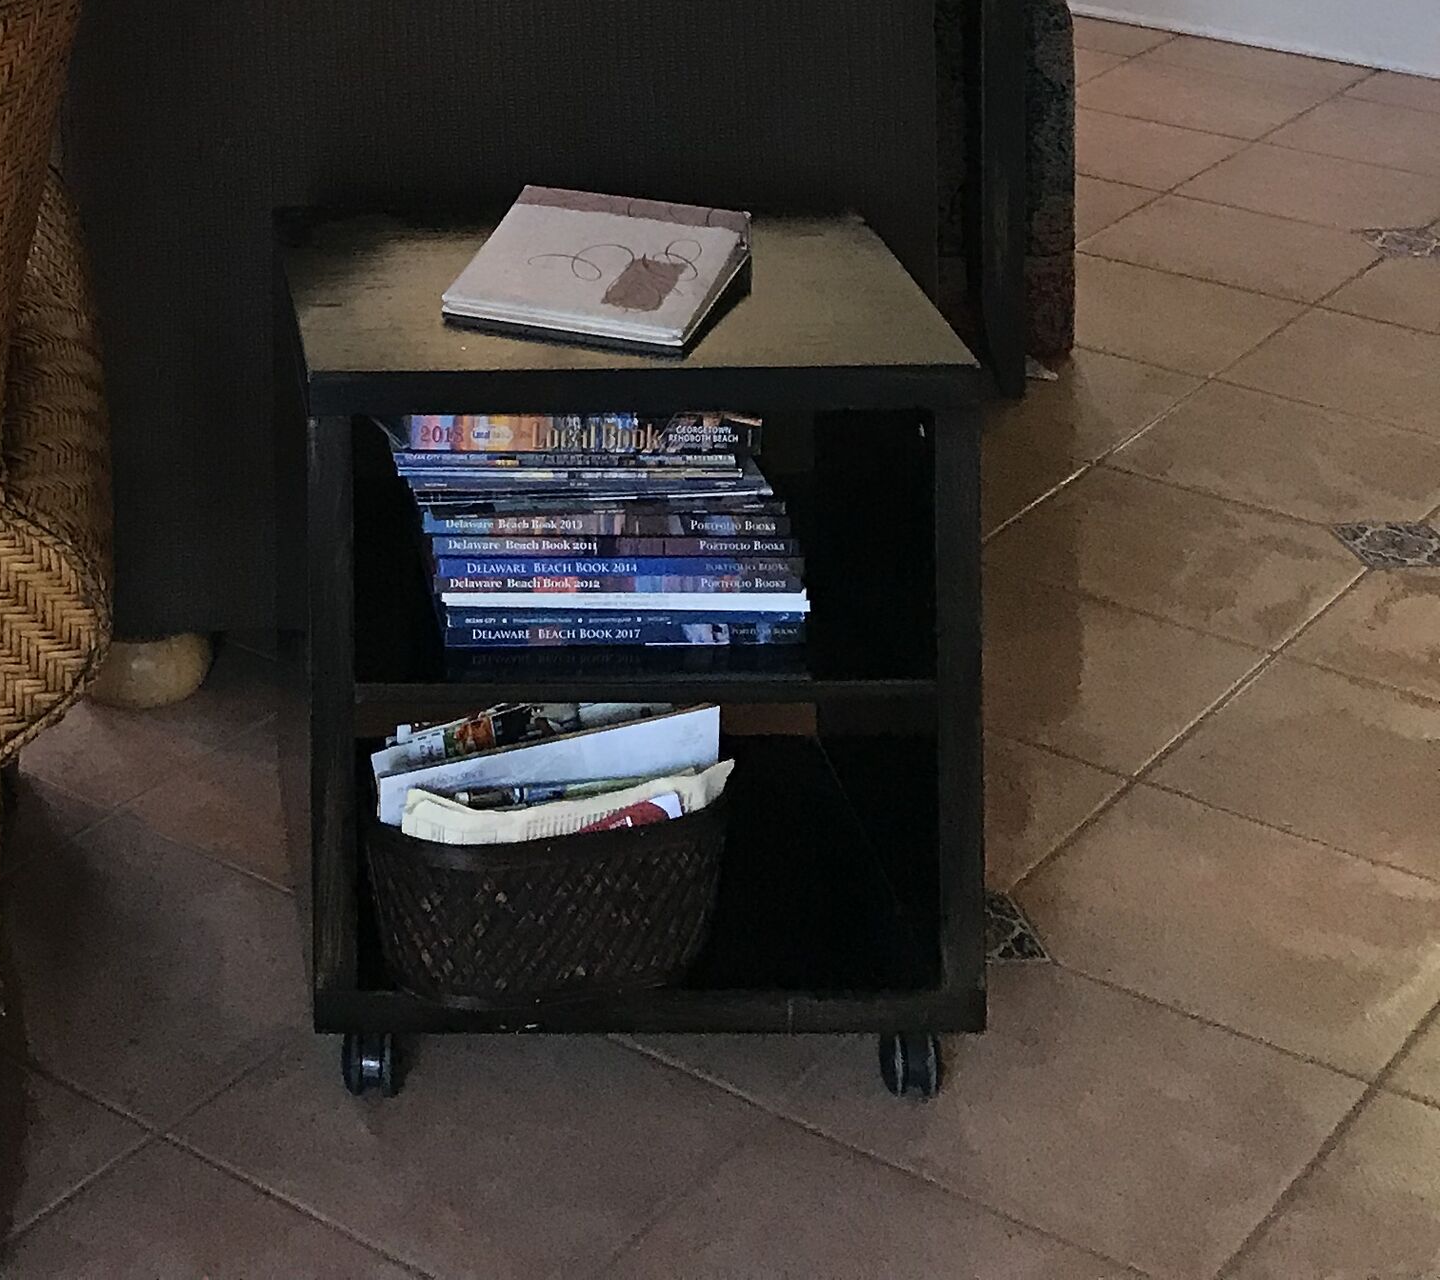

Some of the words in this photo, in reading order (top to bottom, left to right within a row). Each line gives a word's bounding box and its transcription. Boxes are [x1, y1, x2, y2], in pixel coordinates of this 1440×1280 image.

[675, 425, 732, 435] GEORGETOWN
[532, 421, 596, 449] Local
[602, 423, 660, 450] Book
[668, 433, 711, 443] REHOBOTH
[712, 434, 739, 443] BEACH
[445, 519, 494, 529] Delaware
[498, 519, 530, 529] Beach
[531, 519, 557, 529] Book
[448, 540, 501, 550] Delaware
[505, 540, 539, 550] Beach
[541, 540, 571, 550] Book
[467, 562, 527, 574] DELAWARE
[533, 562, 572, 573] BEACH
[575, 562, 609, 573] BOOK
[611, 562, 638, 573] 2014
[449, 578, 503, 588] Delaware
[507, 578, 541, 588] Beach
[543, 578, 571, 588] Book
[573, 580, 601, 589] 2012
[472, 628, 531, 640] DELAWARE
[538, 628, 576, 640] BEACH
[579, 628, 613, 640] BOOK
[615, 628, 641, 640] 2017
